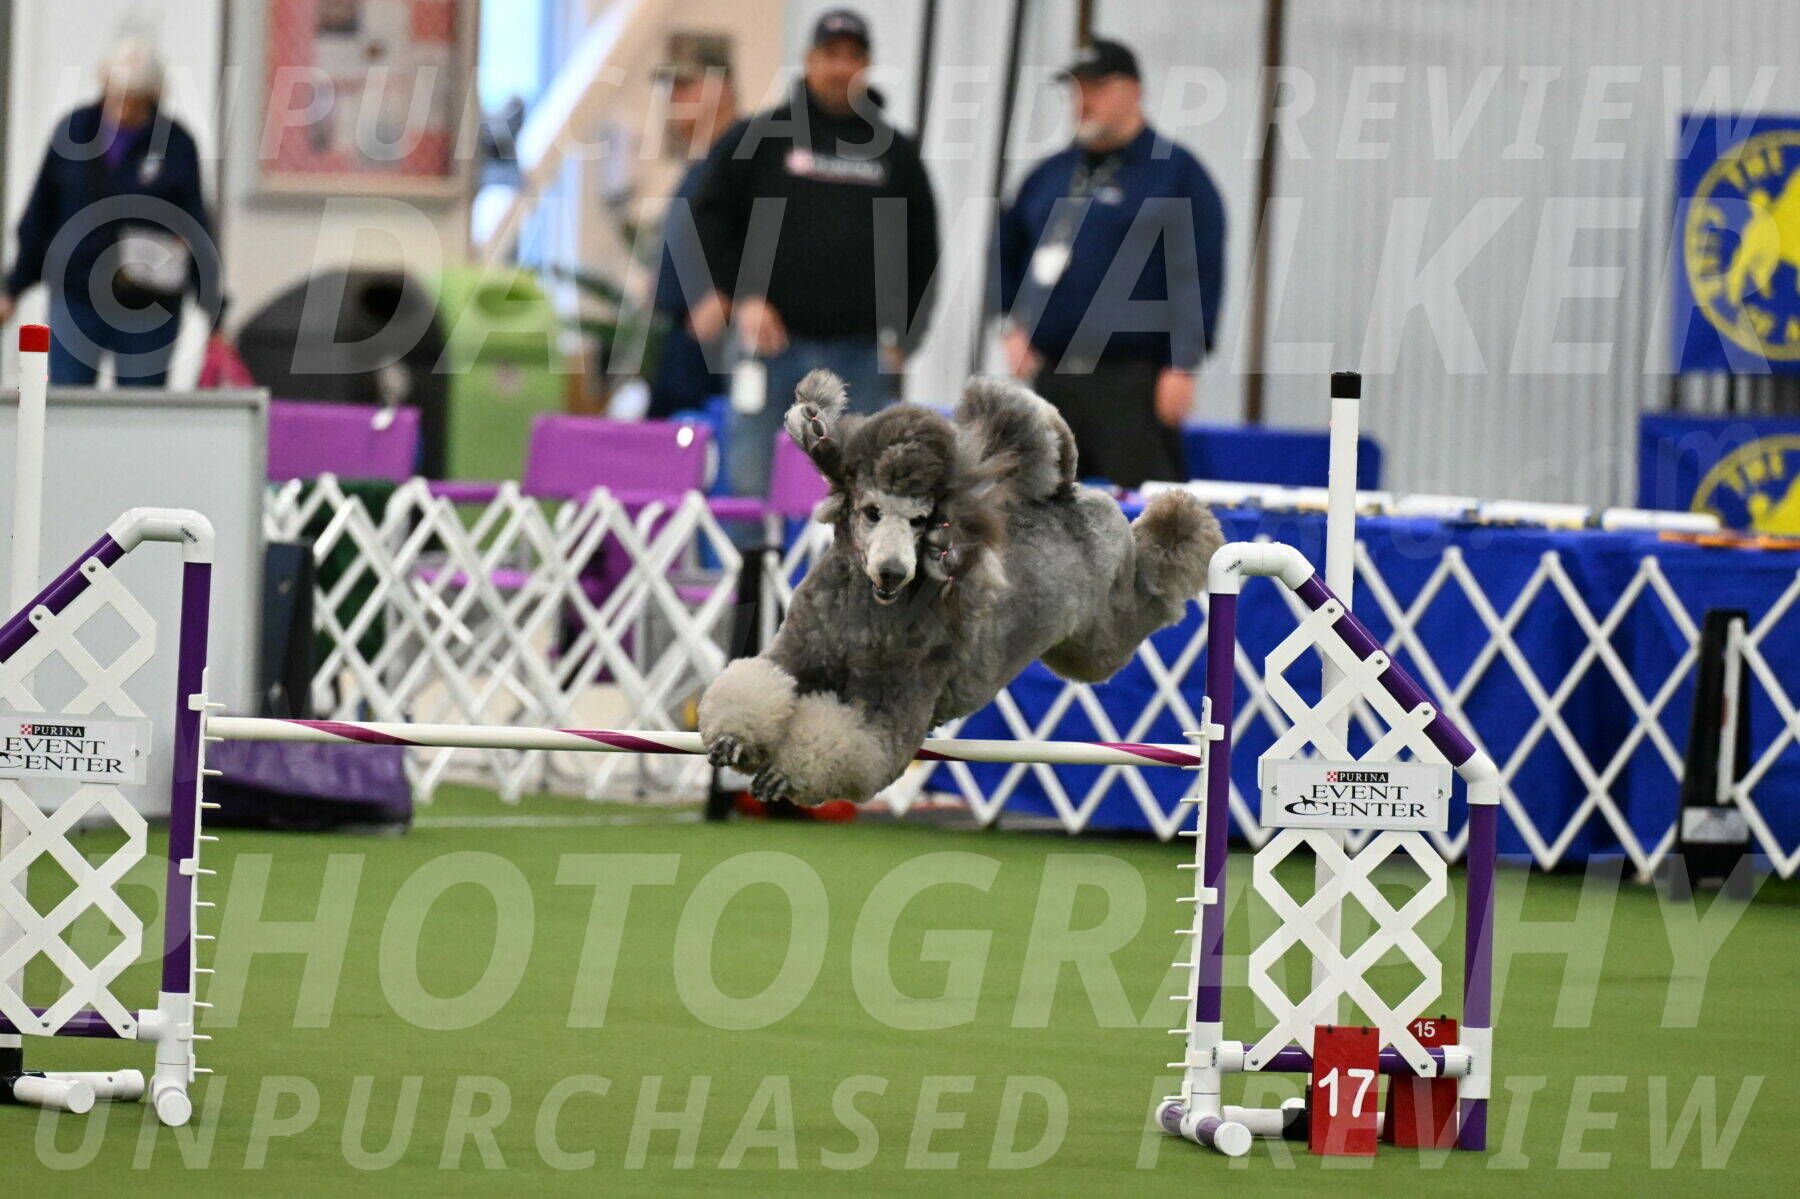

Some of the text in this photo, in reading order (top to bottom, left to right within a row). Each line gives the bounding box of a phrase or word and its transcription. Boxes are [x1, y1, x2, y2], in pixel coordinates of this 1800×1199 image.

[33, 725, 83, 737] PURINA
[5, 737, 105, 755] EVENT
[1339, 772, 1388, 783] PURINA
[1311, 784, 1409, 801] EVENT
[1284, 800, 1428, 818] CENTER
[1414, 1020, 1436, 1038] 15
[1318, 1067, 1375, 1118] 17
